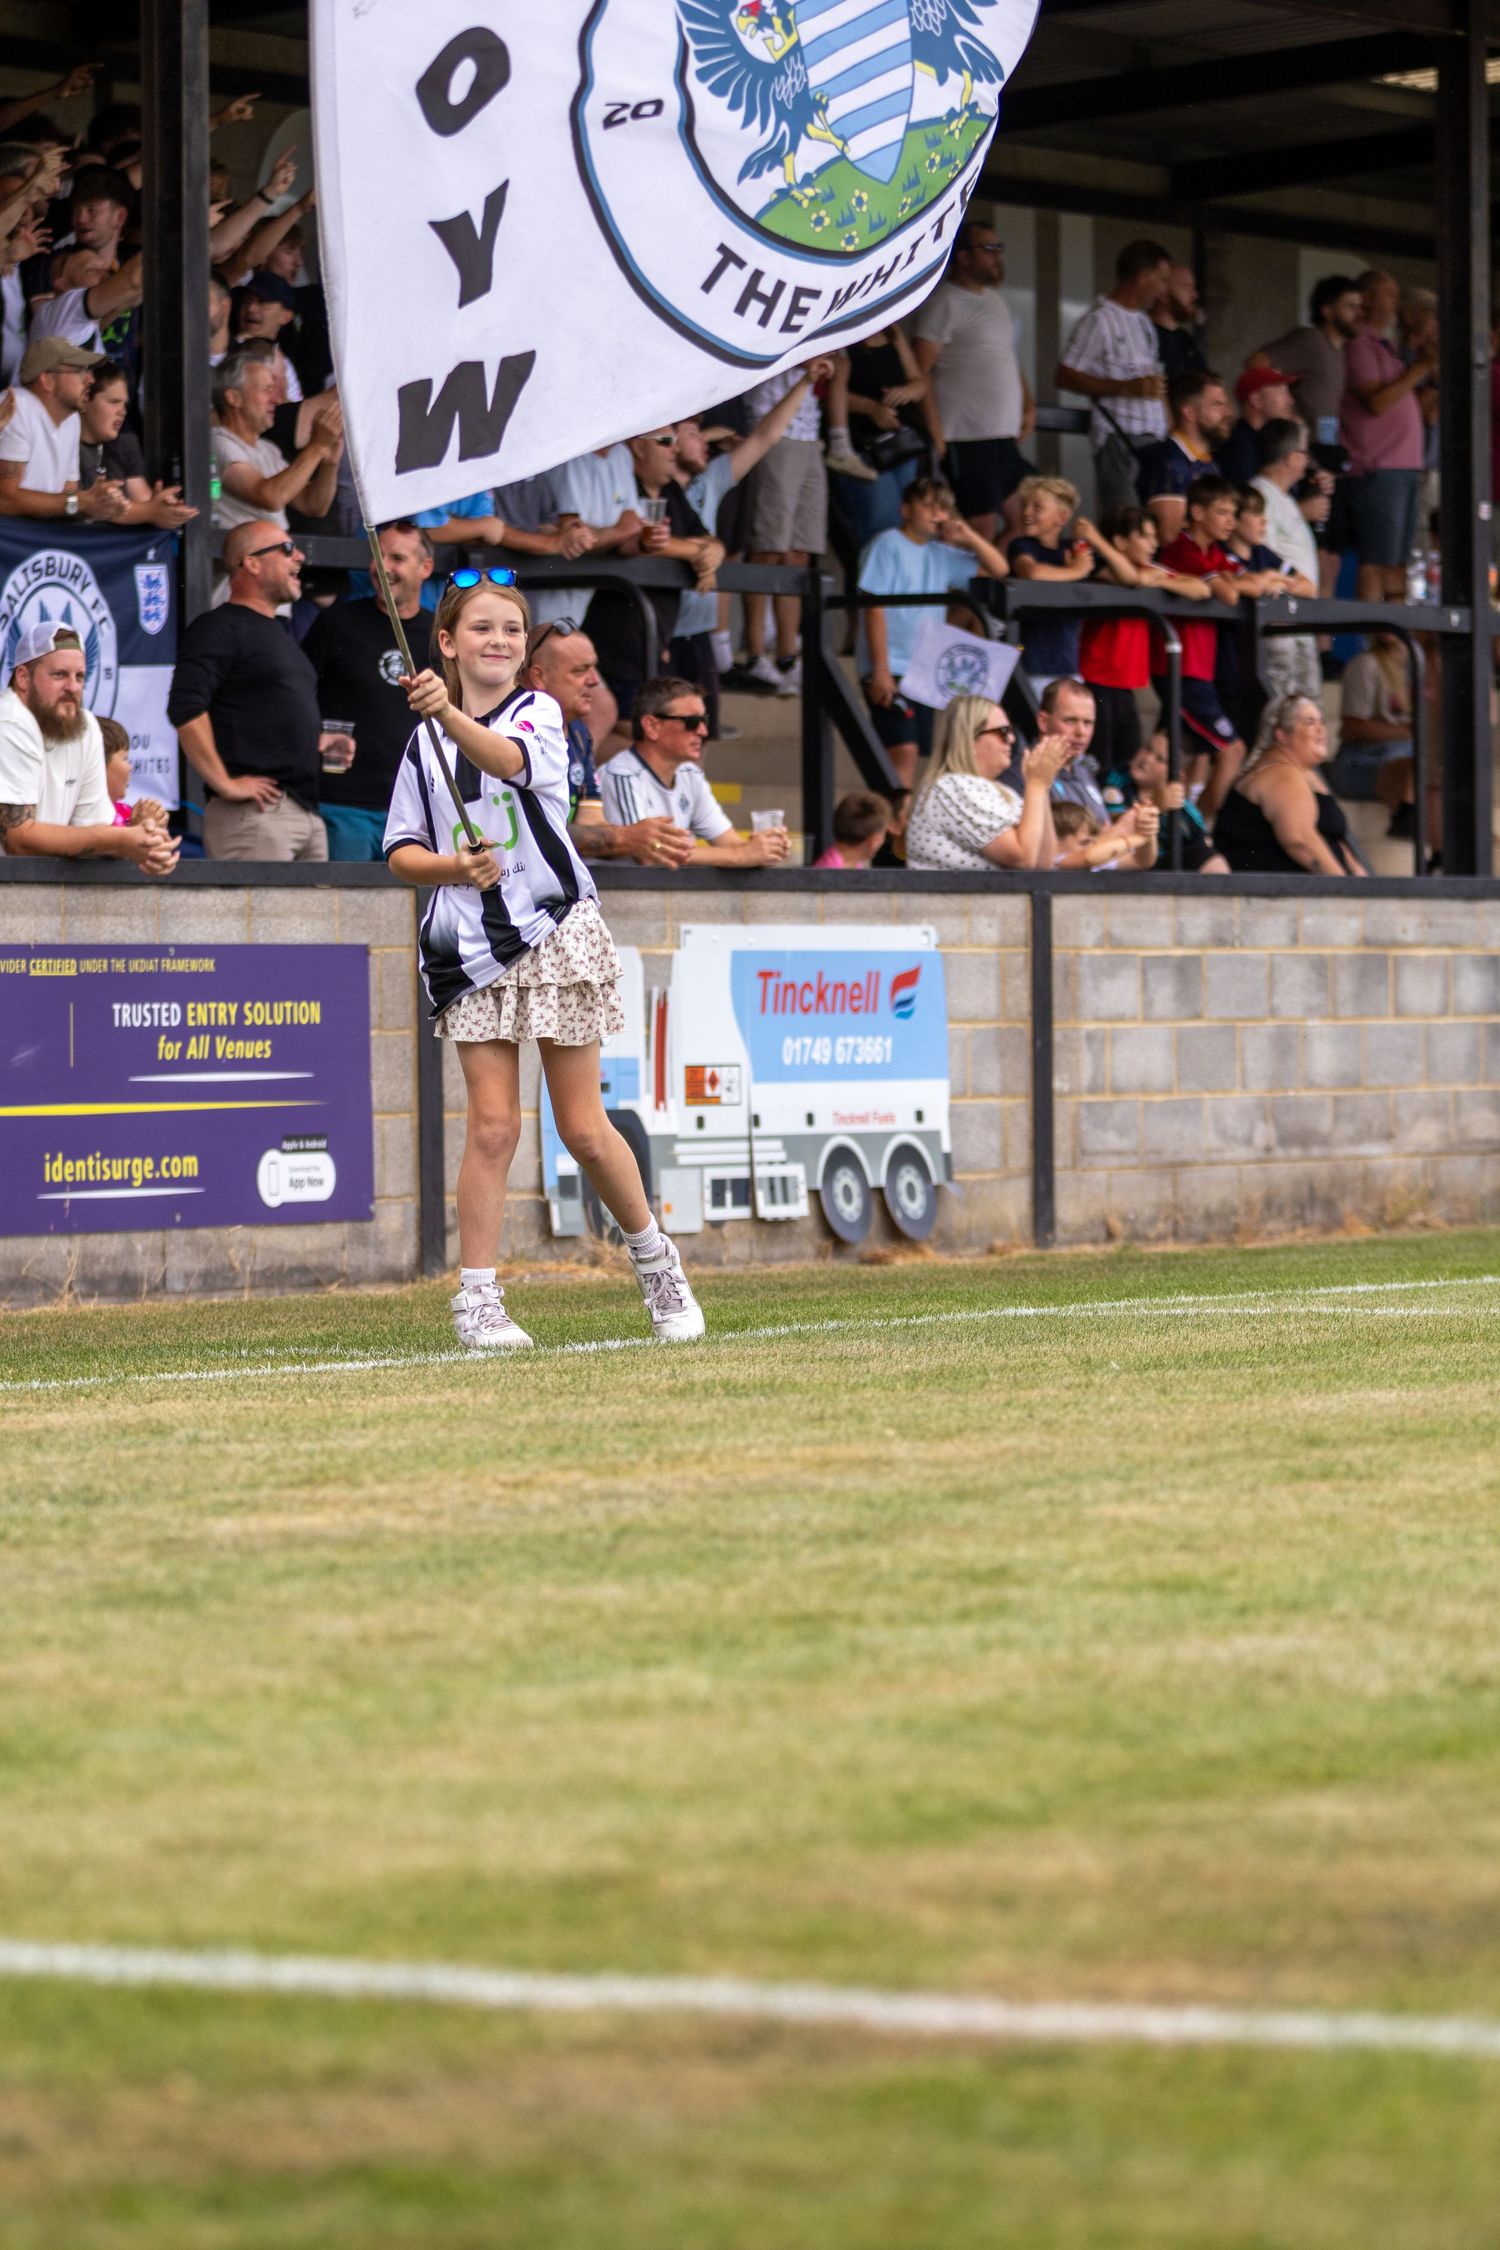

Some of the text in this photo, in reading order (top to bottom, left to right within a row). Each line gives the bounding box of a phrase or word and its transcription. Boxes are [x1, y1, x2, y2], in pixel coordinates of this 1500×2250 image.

[602, 98, 664, 130] 20
[700, 243, 822, 335] THE
[131, 757, 170, 774] HITES
[29, 958, 78, 976] CERTIFIED
[80, 959, 108, 973] UNDER
[111, 958, 126, 973] THE
[161, 958, 216, 973] FRAMEWORK
[757, 971, 881, 1015] Tincknell
[112, 1001, 321, 1028] TRUSTED ENTRY SOLUTION
[157, 1035, 272, 1060] for All Venues
[782, 1036, 832, 1065] 01749
[44, 1154, 199, 1187] identisurge.com
[289, 1176, 324, 1189] App Now
